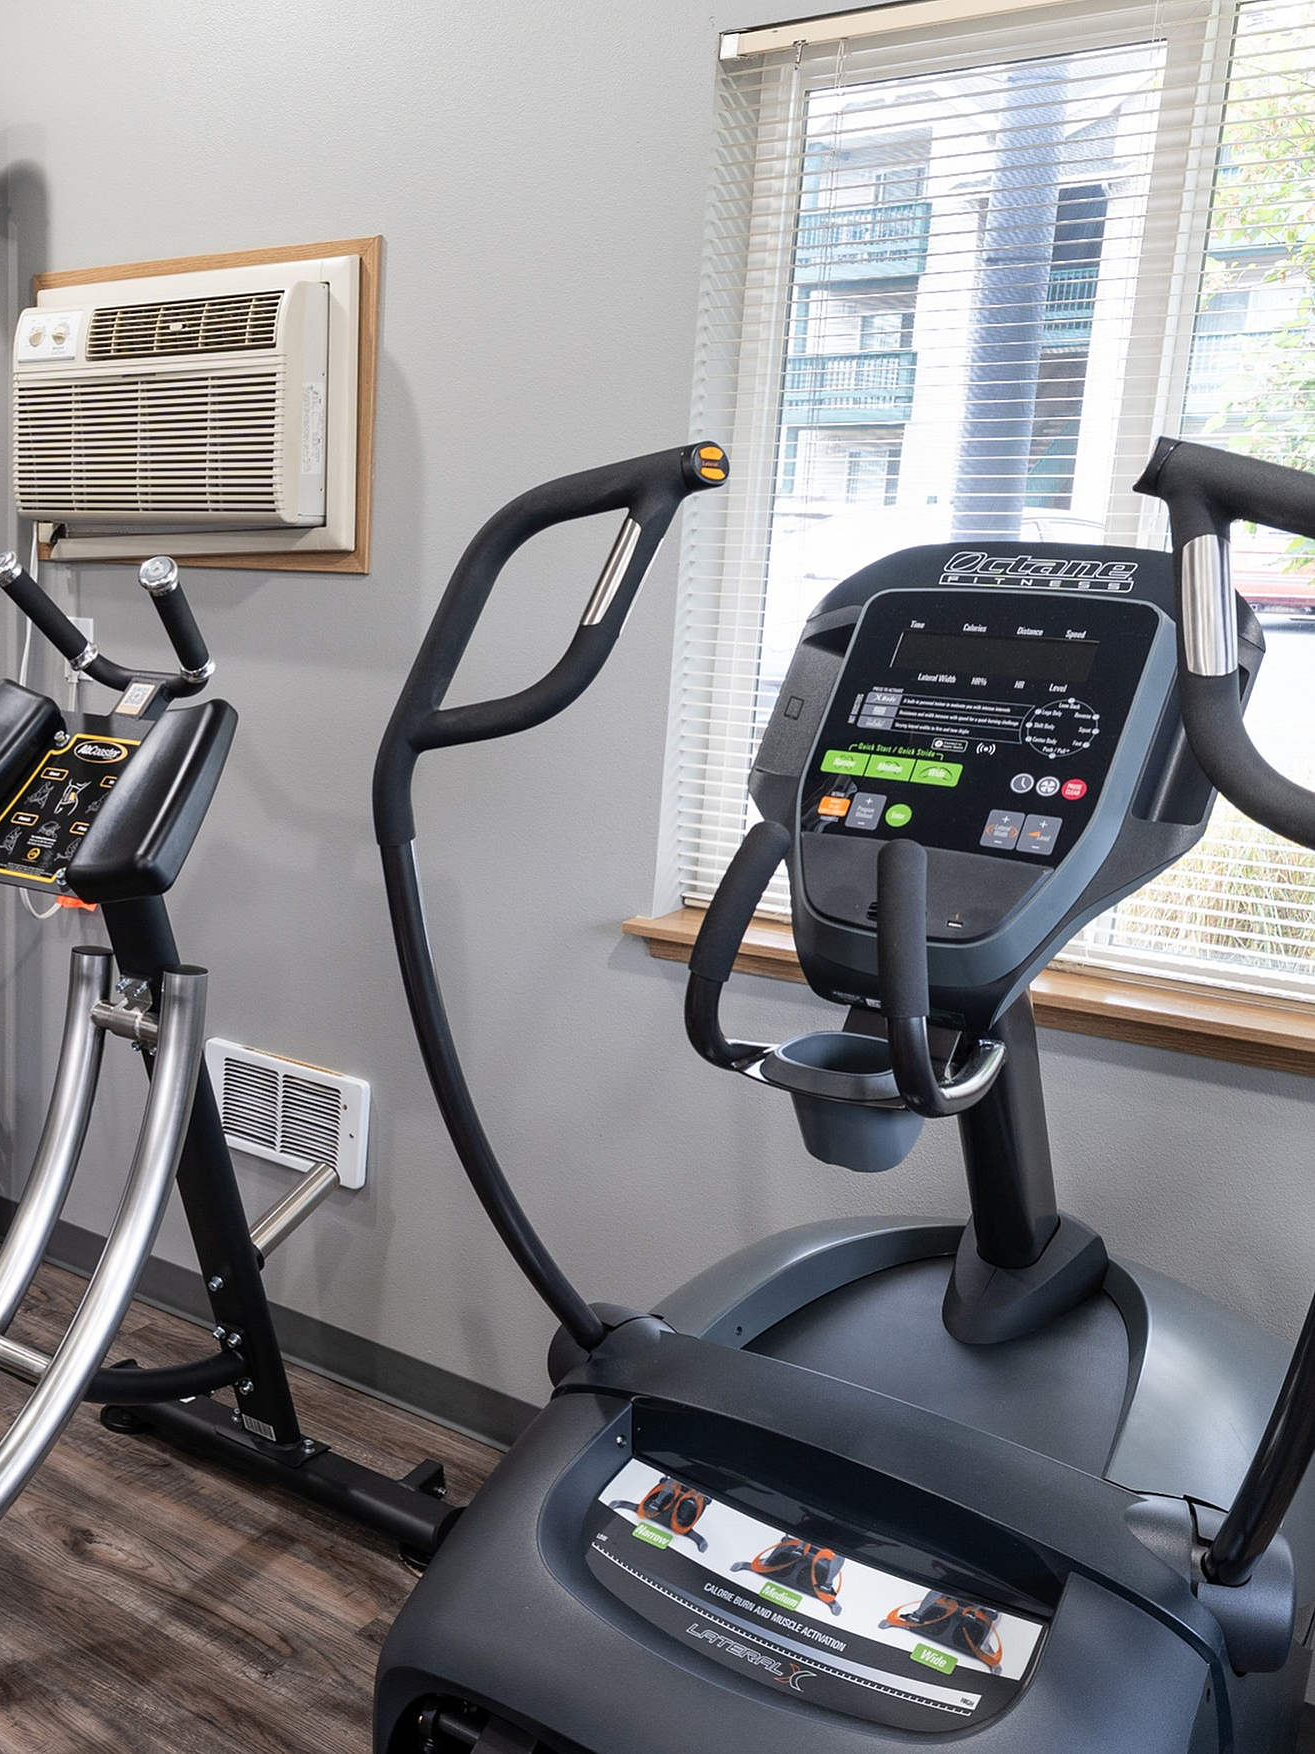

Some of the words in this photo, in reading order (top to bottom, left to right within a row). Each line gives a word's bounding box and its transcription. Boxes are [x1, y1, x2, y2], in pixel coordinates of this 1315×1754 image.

[943, 551, 1139, 580] Octane
[947, 576, 1121, 591] FITNESS
[910, 619, 926, 629] Time
[962, 623, 987, 633] Calories
[1016, 626, 1044, 637] Distance
[1065, 629, 1087, 640] Speed
[917, 672, 938, 682] Lateral
[938, 674, 957, 684] Width
[970, 677, 988, 687] HR%
[1013, 680, 1026, 690] HR
[1048, 682, 1068, 693] Level
[77, 744, 121, 758] AbCoaster
[858, 742, 875, 752] Quick
[876, 743, 892, 753] Start
[898, 746, 916, 756] Quick
[916, 748, 935, 758] Stride
[928, 767, 946, 778] Wide
[890, 811, 905, 820] Enter
[596, 1532, 609, 1543] LOW
[634, 1523, 670, 1547] Narrow
[761, 1585, 799, 1609] Medium
[703, 1582, 734, 1603] CALORIE
[734, 1595, 755, 1612] BURN
[753, 1605, 773, 1620] AND
[771, 1612, 803, 1634] MUSCLE
[802, 1627, 847, 1653] ACTIVATION
[920, 1648, 948, 1668] Wide
[959, 1697, 975, 1707] HIGH
